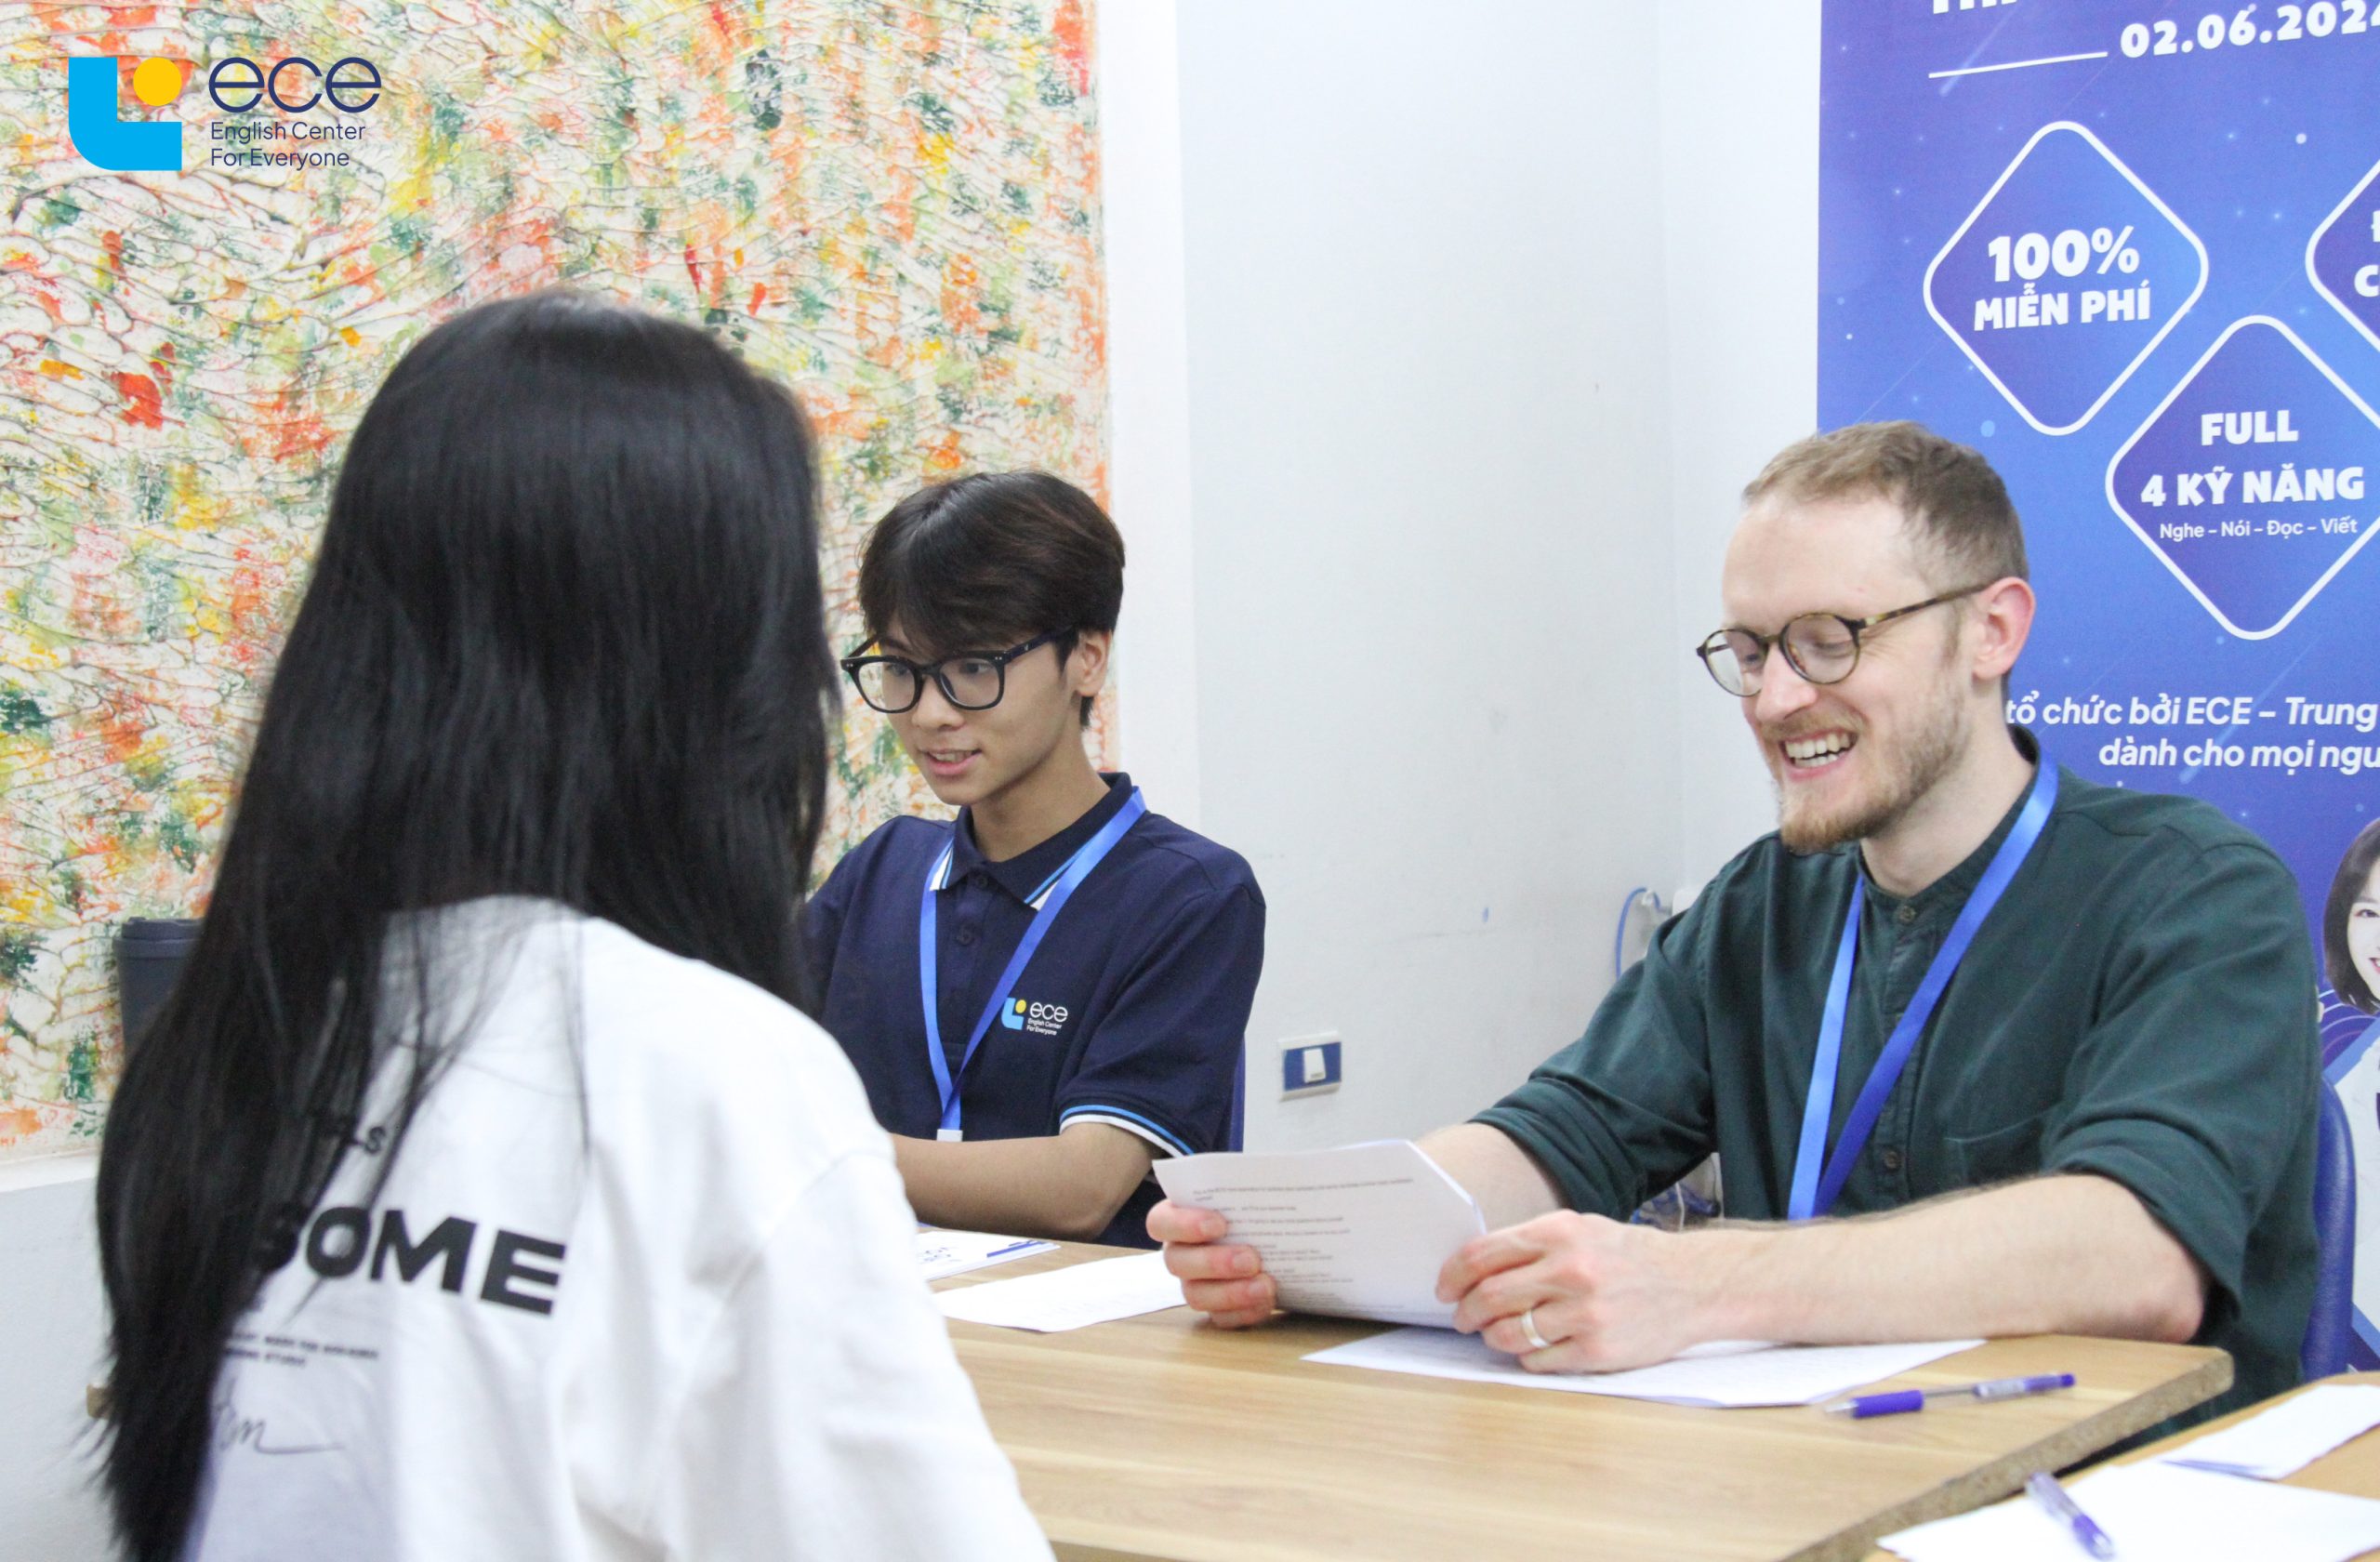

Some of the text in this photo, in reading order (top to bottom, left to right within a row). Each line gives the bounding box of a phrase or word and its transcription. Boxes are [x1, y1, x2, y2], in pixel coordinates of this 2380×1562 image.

[1988, 225, 2139, 282] 100%
[1974, 279, 2150, 331] MIỄN PHÍ
[2202, 409, 2299, 445] FULL
[2140, 463, 2364, 507] 4 KỸ NĂNG
[2160, 523, 2204, 542] Nghe
[2220, 520, 2251, 536] Nói
[2267, 520, 2304, 539] Đọc
[2320, 515, 2359, 534] Viết
[2005, 690, 2040, 724] tổ
[2043, 695, 2122, 725] chức
[2129, 693, 2181, 725] bởi
[2186, 696, 2254, 725] ECE
[2284, 696, 2378, 733] Trung
[2098, 735, 2177, 766] dành
[2183, 739, 2246, 766] cho
[2250, 739, 2315, 775] mọi
[1026, 1024, 1057, 1036] For Everyone
[1027, 1017, 1062, 1029] English Center
[1029, 1001, 1068, 1023] ece
